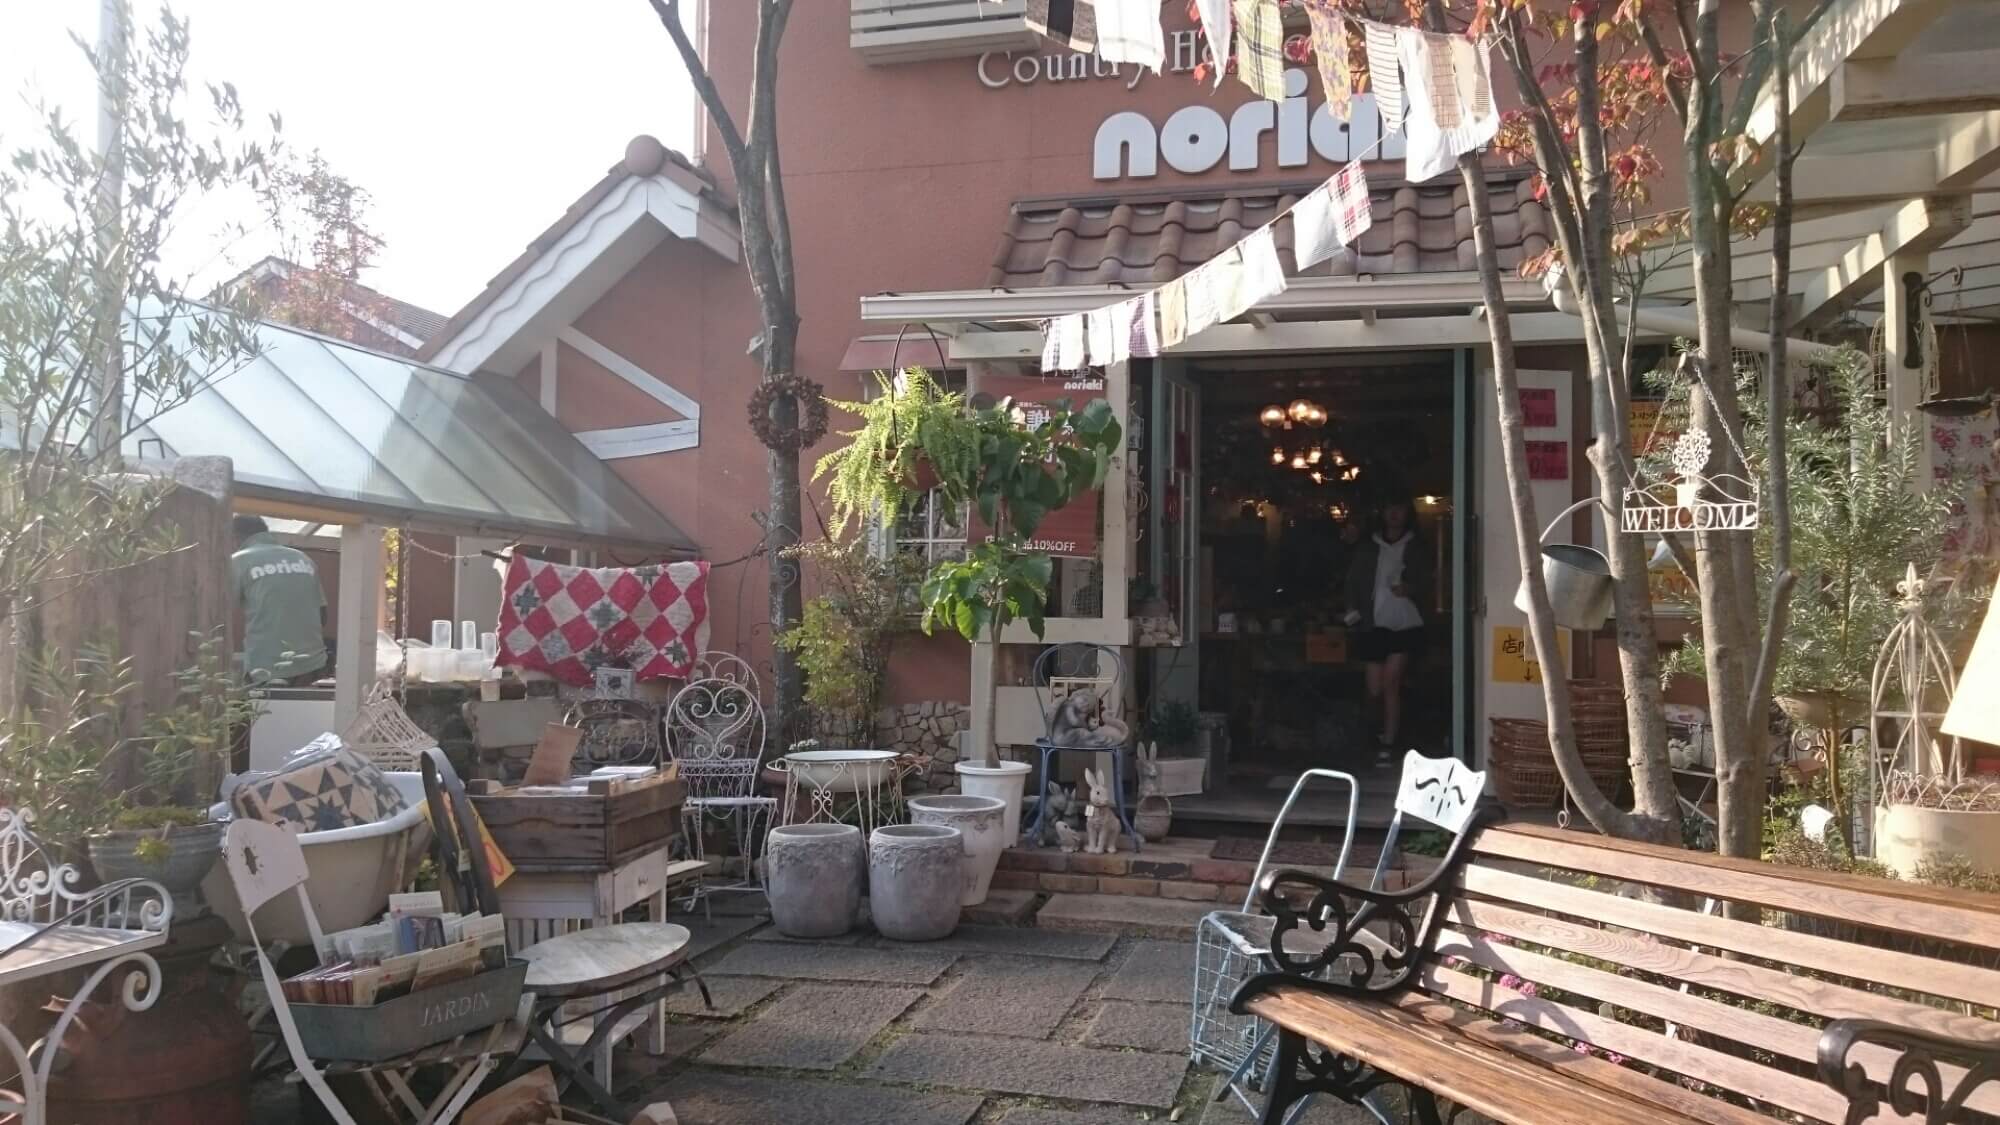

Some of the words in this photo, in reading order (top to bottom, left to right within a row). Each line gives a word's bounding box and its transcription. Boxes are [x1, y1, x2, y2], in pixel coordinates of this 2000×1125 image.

[1063, 378, 1103, 391] noriaki
[1624, 504, 1757, 531] WELCOME
[422, 991, 489, 1027] JARDIN
